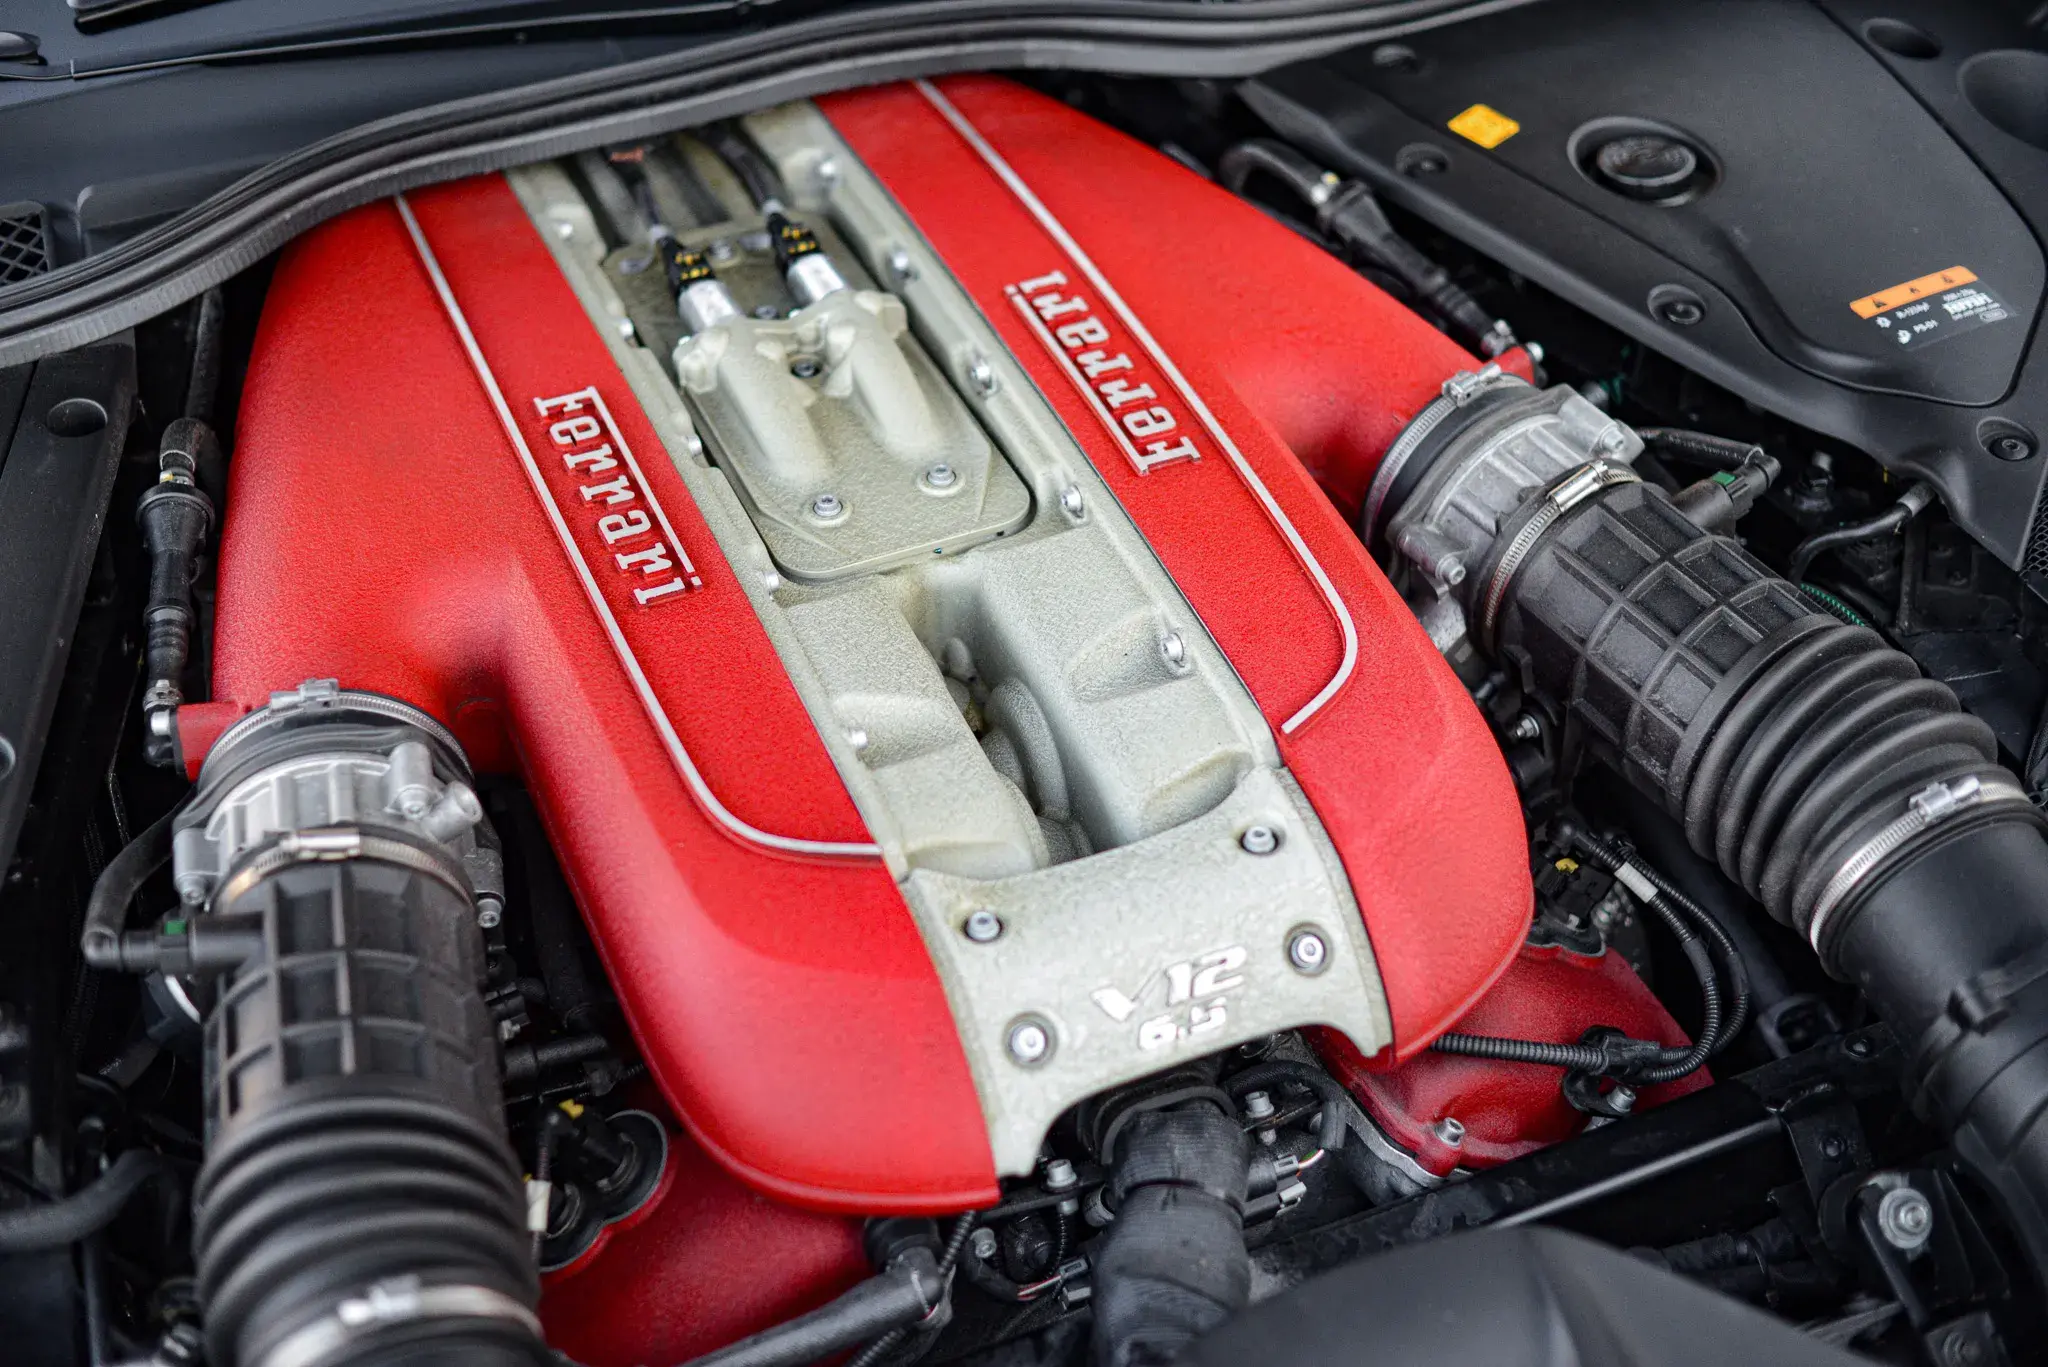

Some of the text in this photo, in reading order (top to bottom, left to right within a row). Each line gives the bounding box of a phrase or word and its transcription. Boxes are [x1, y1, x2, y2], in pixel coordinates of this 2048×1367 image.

[1004, 269, 1201, 475] Ferrari
[533, 385, 702, 605] Ferrari
[1090, 944, 1247, 1022] V12
[1138, 996, 1226, 1051] 6.5
